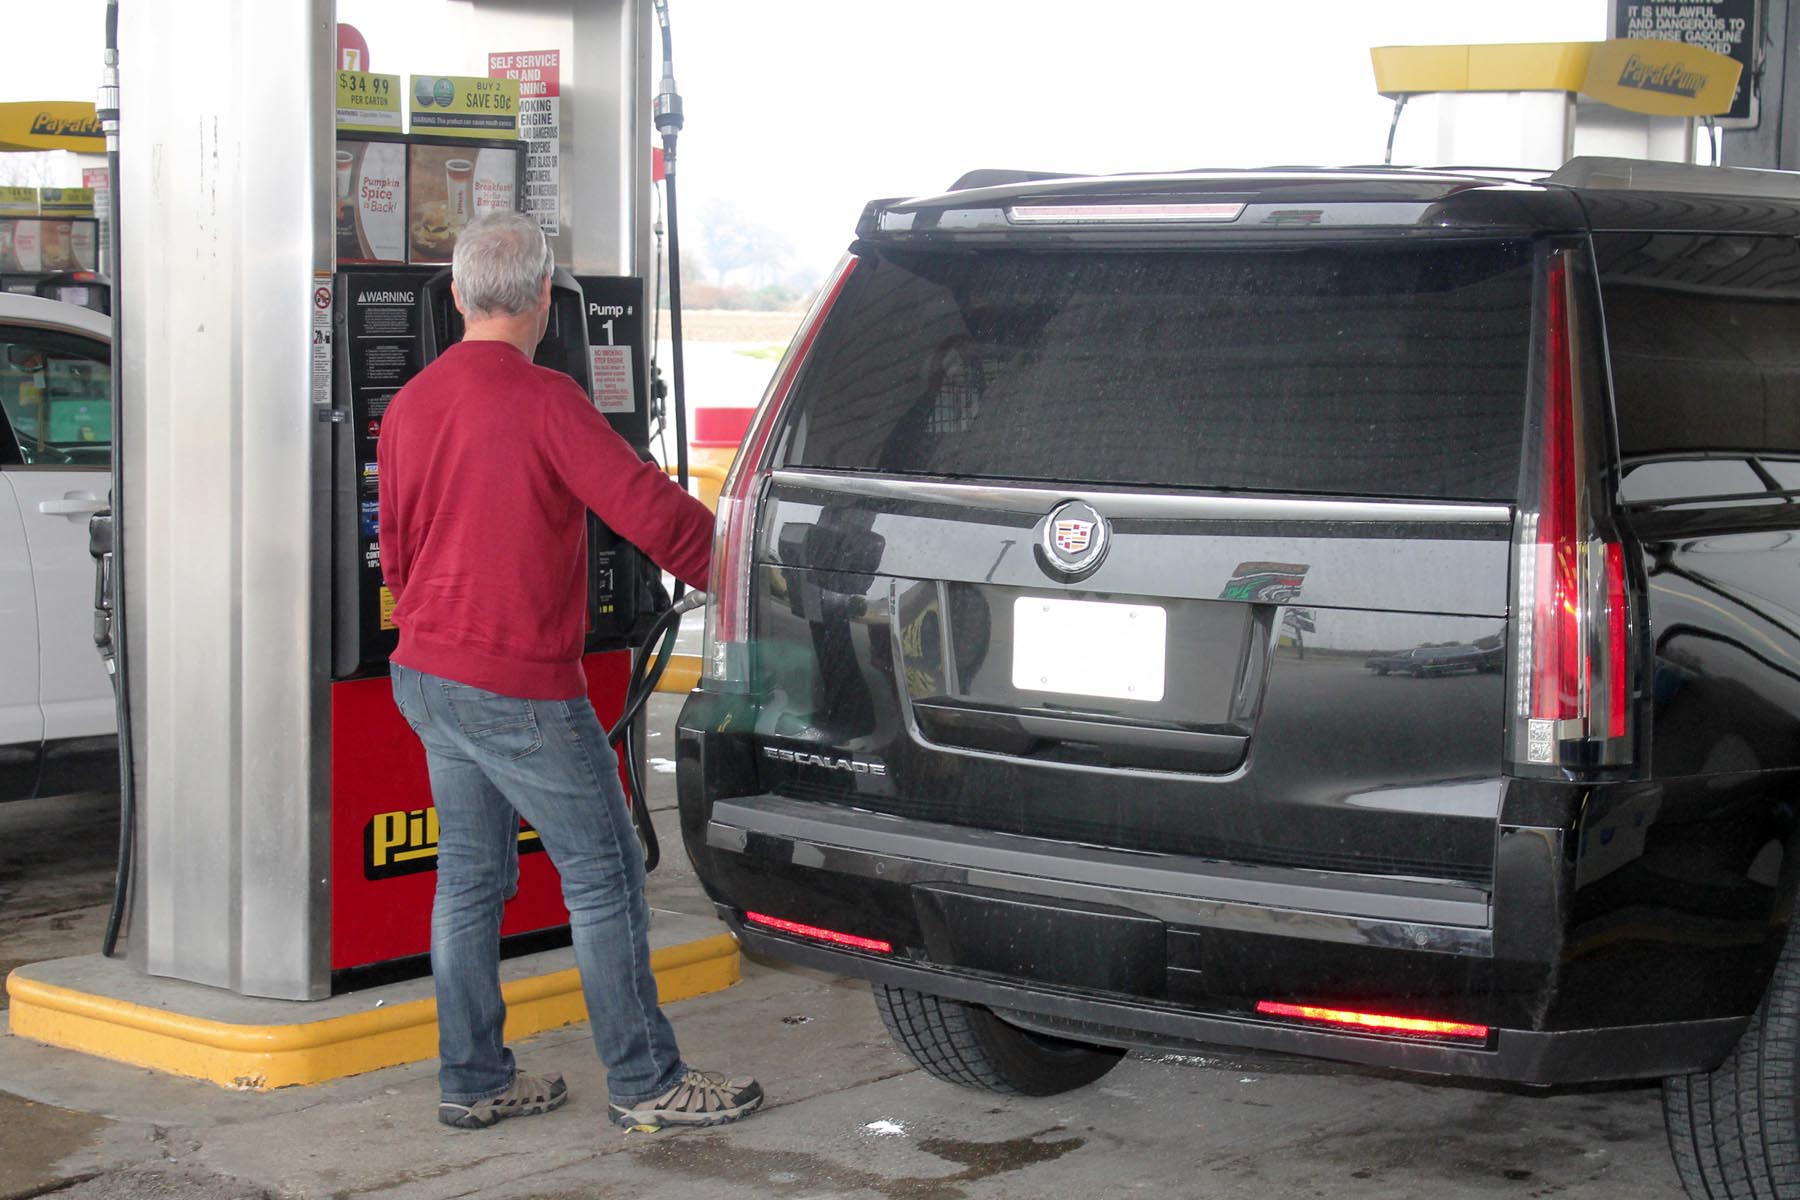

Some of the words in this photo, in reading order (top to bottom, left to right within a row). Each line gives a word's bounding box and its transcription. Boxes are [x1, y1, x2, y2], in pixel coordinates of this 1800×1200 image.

[1628, 5, 1639, 17] IT
[1641, 5, 1652, 17] IS
[1655, 6, 1717, 18] UNLAWFUL
[1628, 19, 1653, 30] AND
[1656, 19, 1725, 30] DANGEROUS
[1728, 18, 1745, 31] TO
[1627, 30, 1682, 40] DISPENSE
[1684, 30, 1742, 43] GASOLINE
[346, 50, 357, 70] 7
[490, 56, 514, 69] SELF
[515, 54, 558, 68] SERVICE
[506, 68, 541, 81] ISLAND
[476, 81, 494, 91] BUY
[496, 83, 501, 91] 2
[519, 81, 547, 95] RNING
[351, 94, 363, 105] PER
[364, 95, 388, 106] CARTON
[466, 93, 490, 108] SAVE
[494, 94, 512, 111] 50¢
[520, 113, 553, 126] ENGINE
[363, 177, 400, 189] Pumpkin
[361, 187, 393, 201] Spice
[370, 200, 397, 213] Back!
[365, 291, 414, 303] WARNING
[589, 303, 623, 317] Pump
[627, 305, 633, 316] #
[602, 320, 614, 346] 1
[763, 746, 886, 776] ESCALADE
[373, 806, 440, 867] Pil
